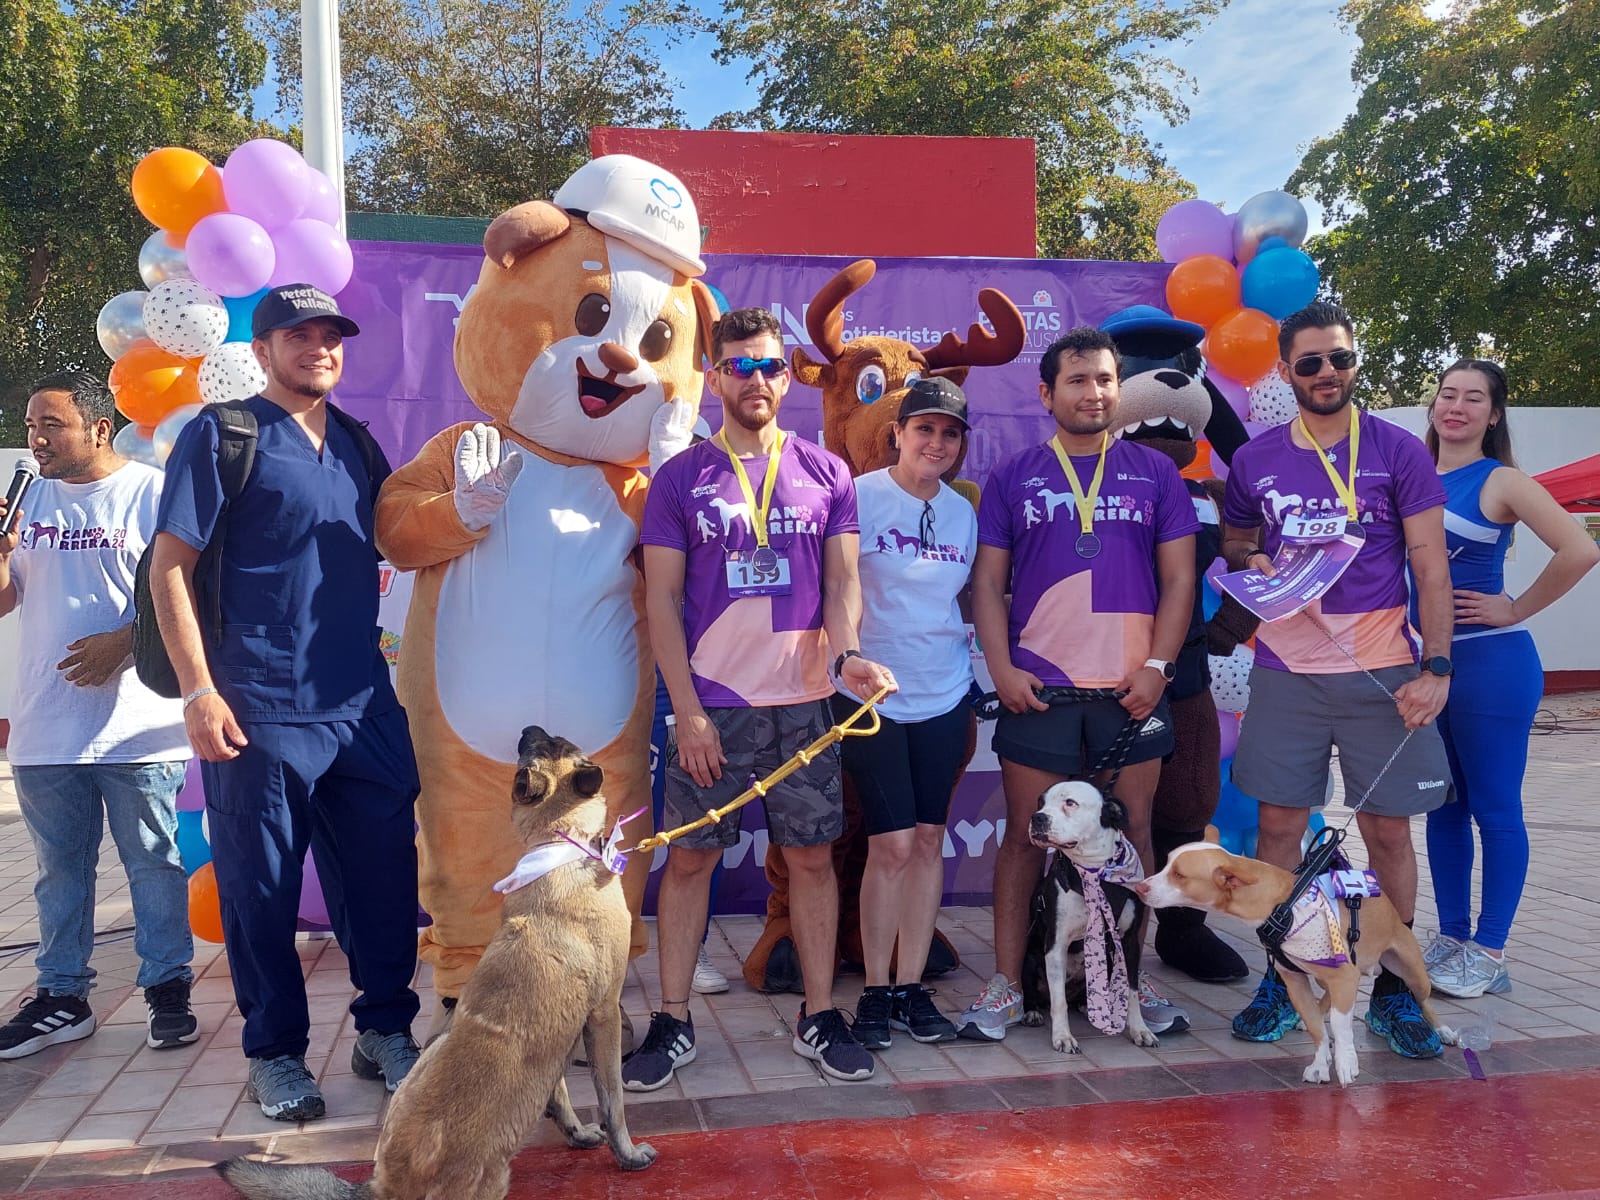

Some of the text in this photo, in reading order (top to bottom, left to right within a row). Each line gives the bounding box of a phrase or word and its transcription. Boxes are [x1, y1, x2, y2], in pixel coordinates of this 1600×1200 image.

[645, 203, 685, 232] MCAP
[1297, 522, 1338, 536] 198
[59, 538, 110, 550] RRERA
[738, 566, 780, 585] 159
[1417, 780, 1445, 790] Wilson
